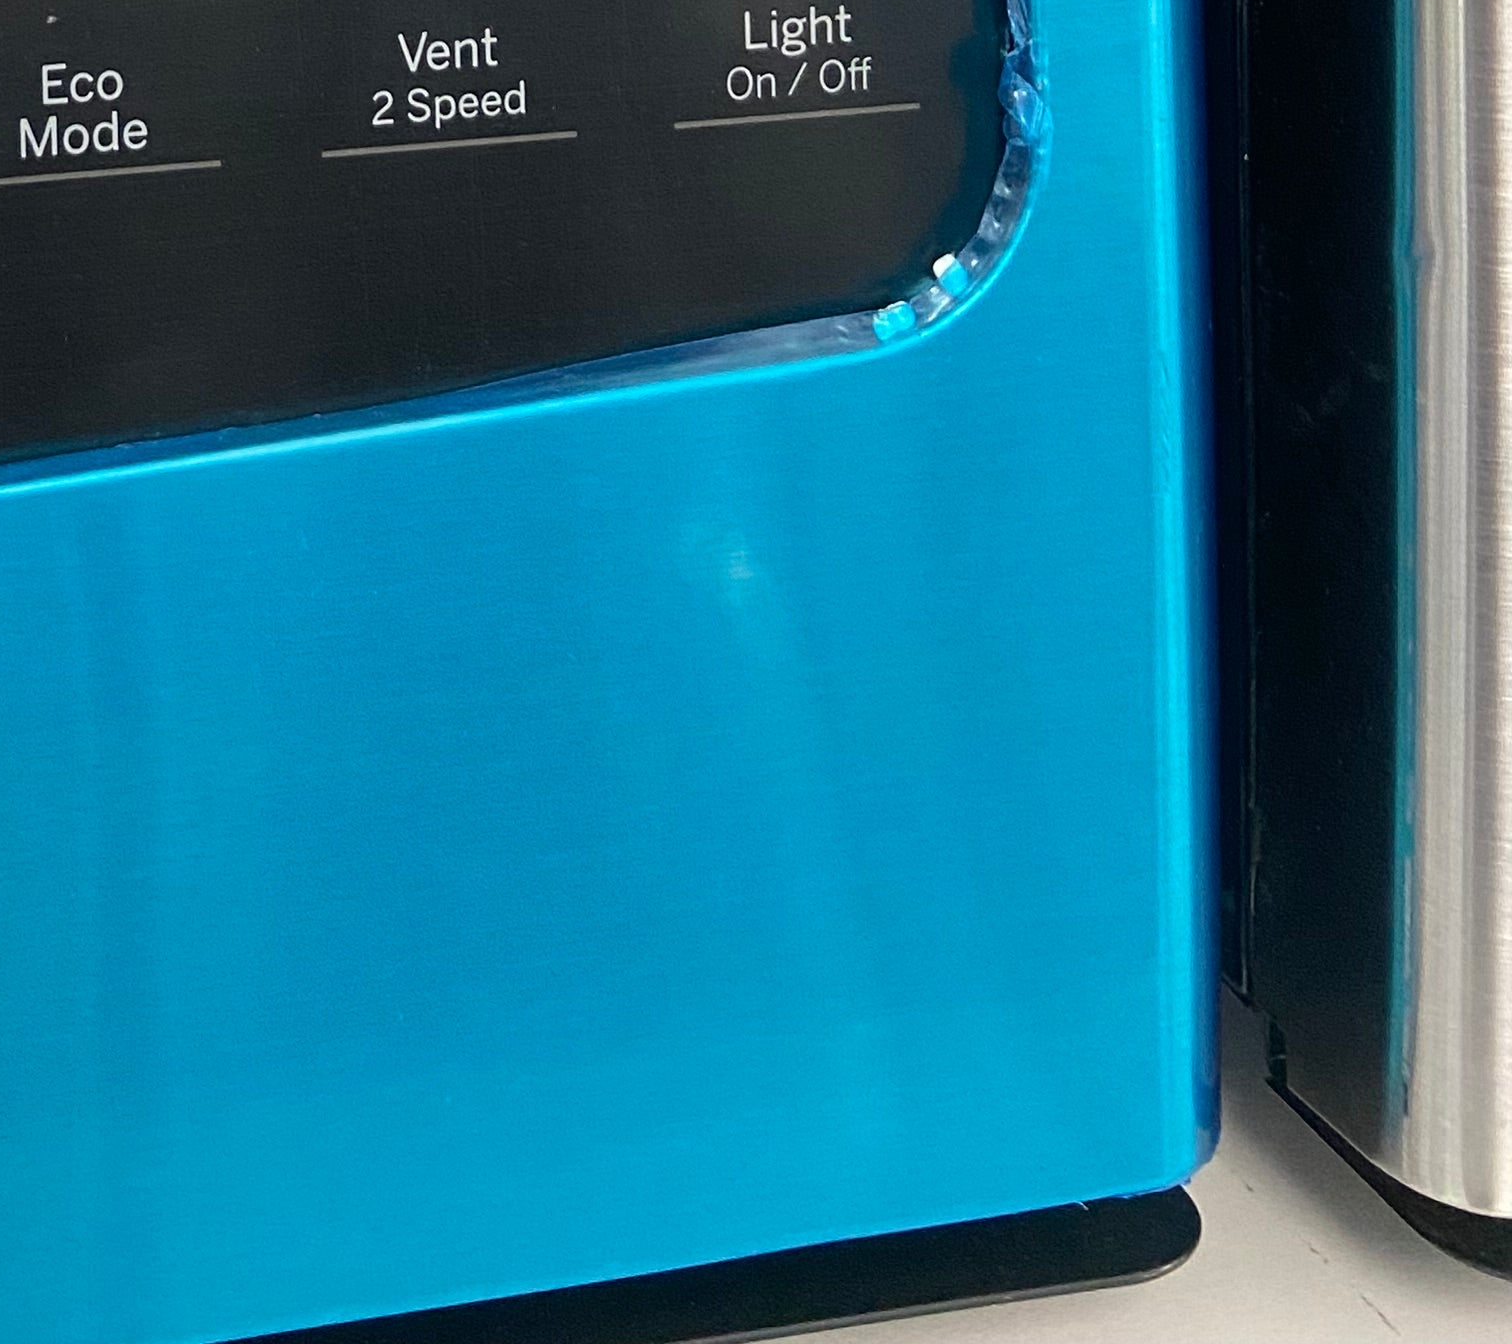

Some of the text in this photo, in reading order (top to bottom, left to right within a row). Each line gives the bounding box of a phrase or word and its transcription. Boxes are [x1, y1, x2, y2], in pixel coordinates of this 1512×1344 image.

[397, 27, 499, 73] Vent
[744, 4, 852, 57] Light
[41, 62, 124, 105] Eco
[726, 56, 872, 101] On / Off
[371, 80, 526, 129] 2 Speed
[19, 110, 148, 159] Mode
